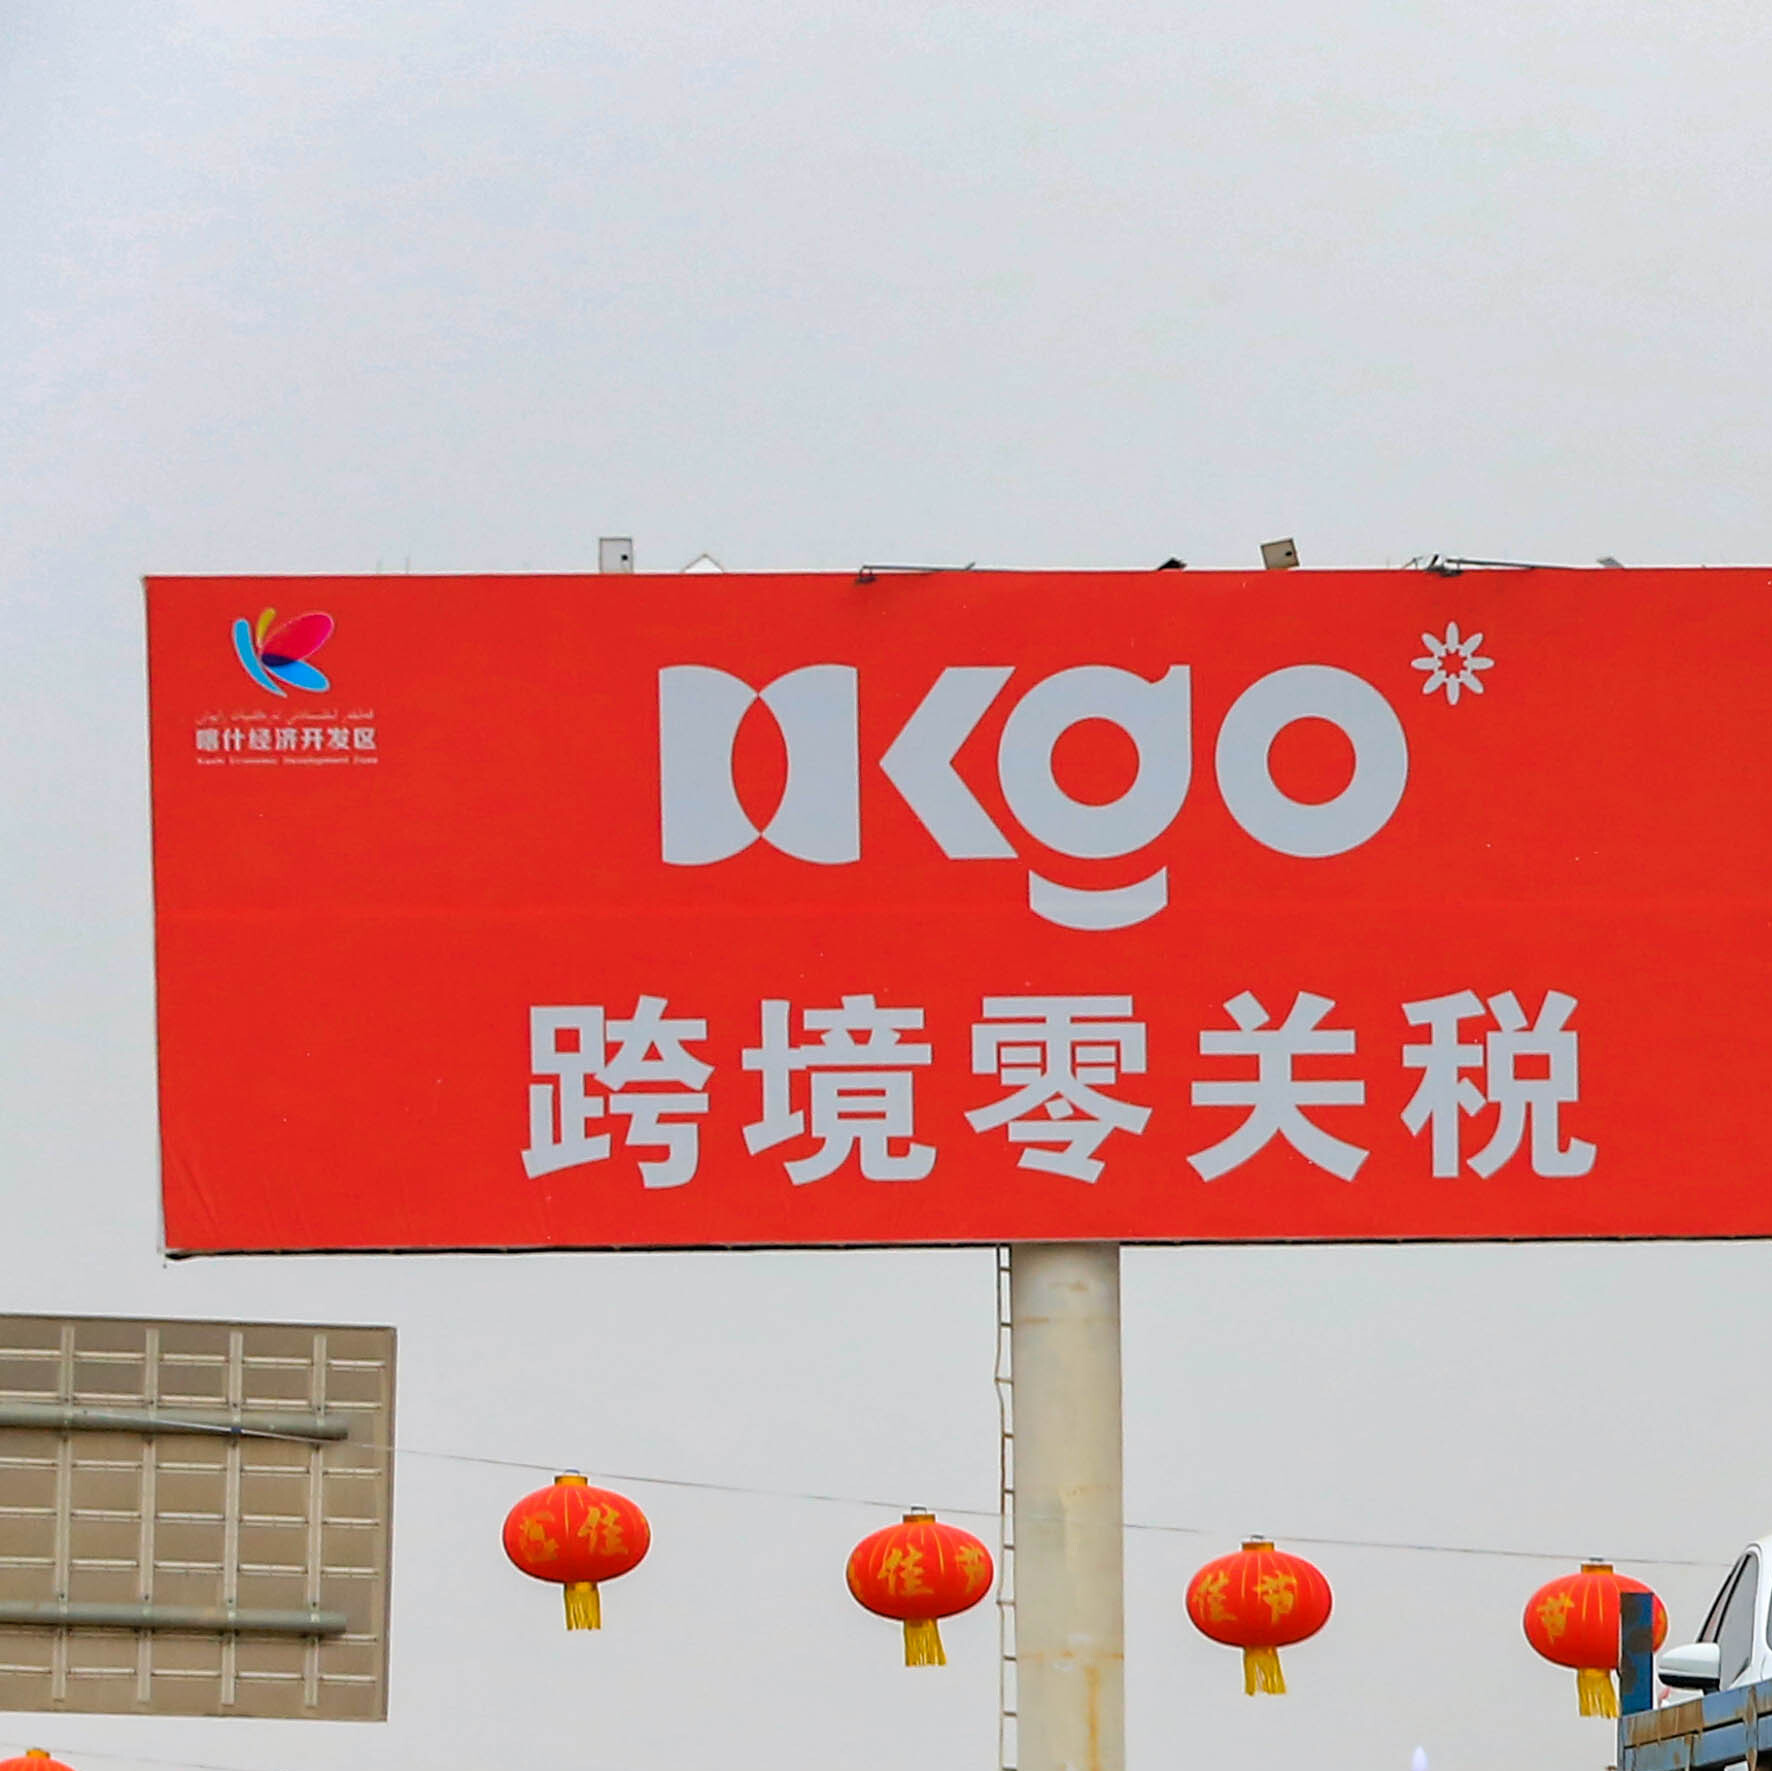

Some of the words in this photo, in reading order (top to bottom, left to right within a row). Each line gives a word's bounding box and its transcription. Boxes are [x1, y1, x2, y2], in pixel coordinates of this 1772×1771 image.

[196, 727, 376, 751] 喀什经济开发区
[520, 989, 1597, 1190] 跨境零关税
